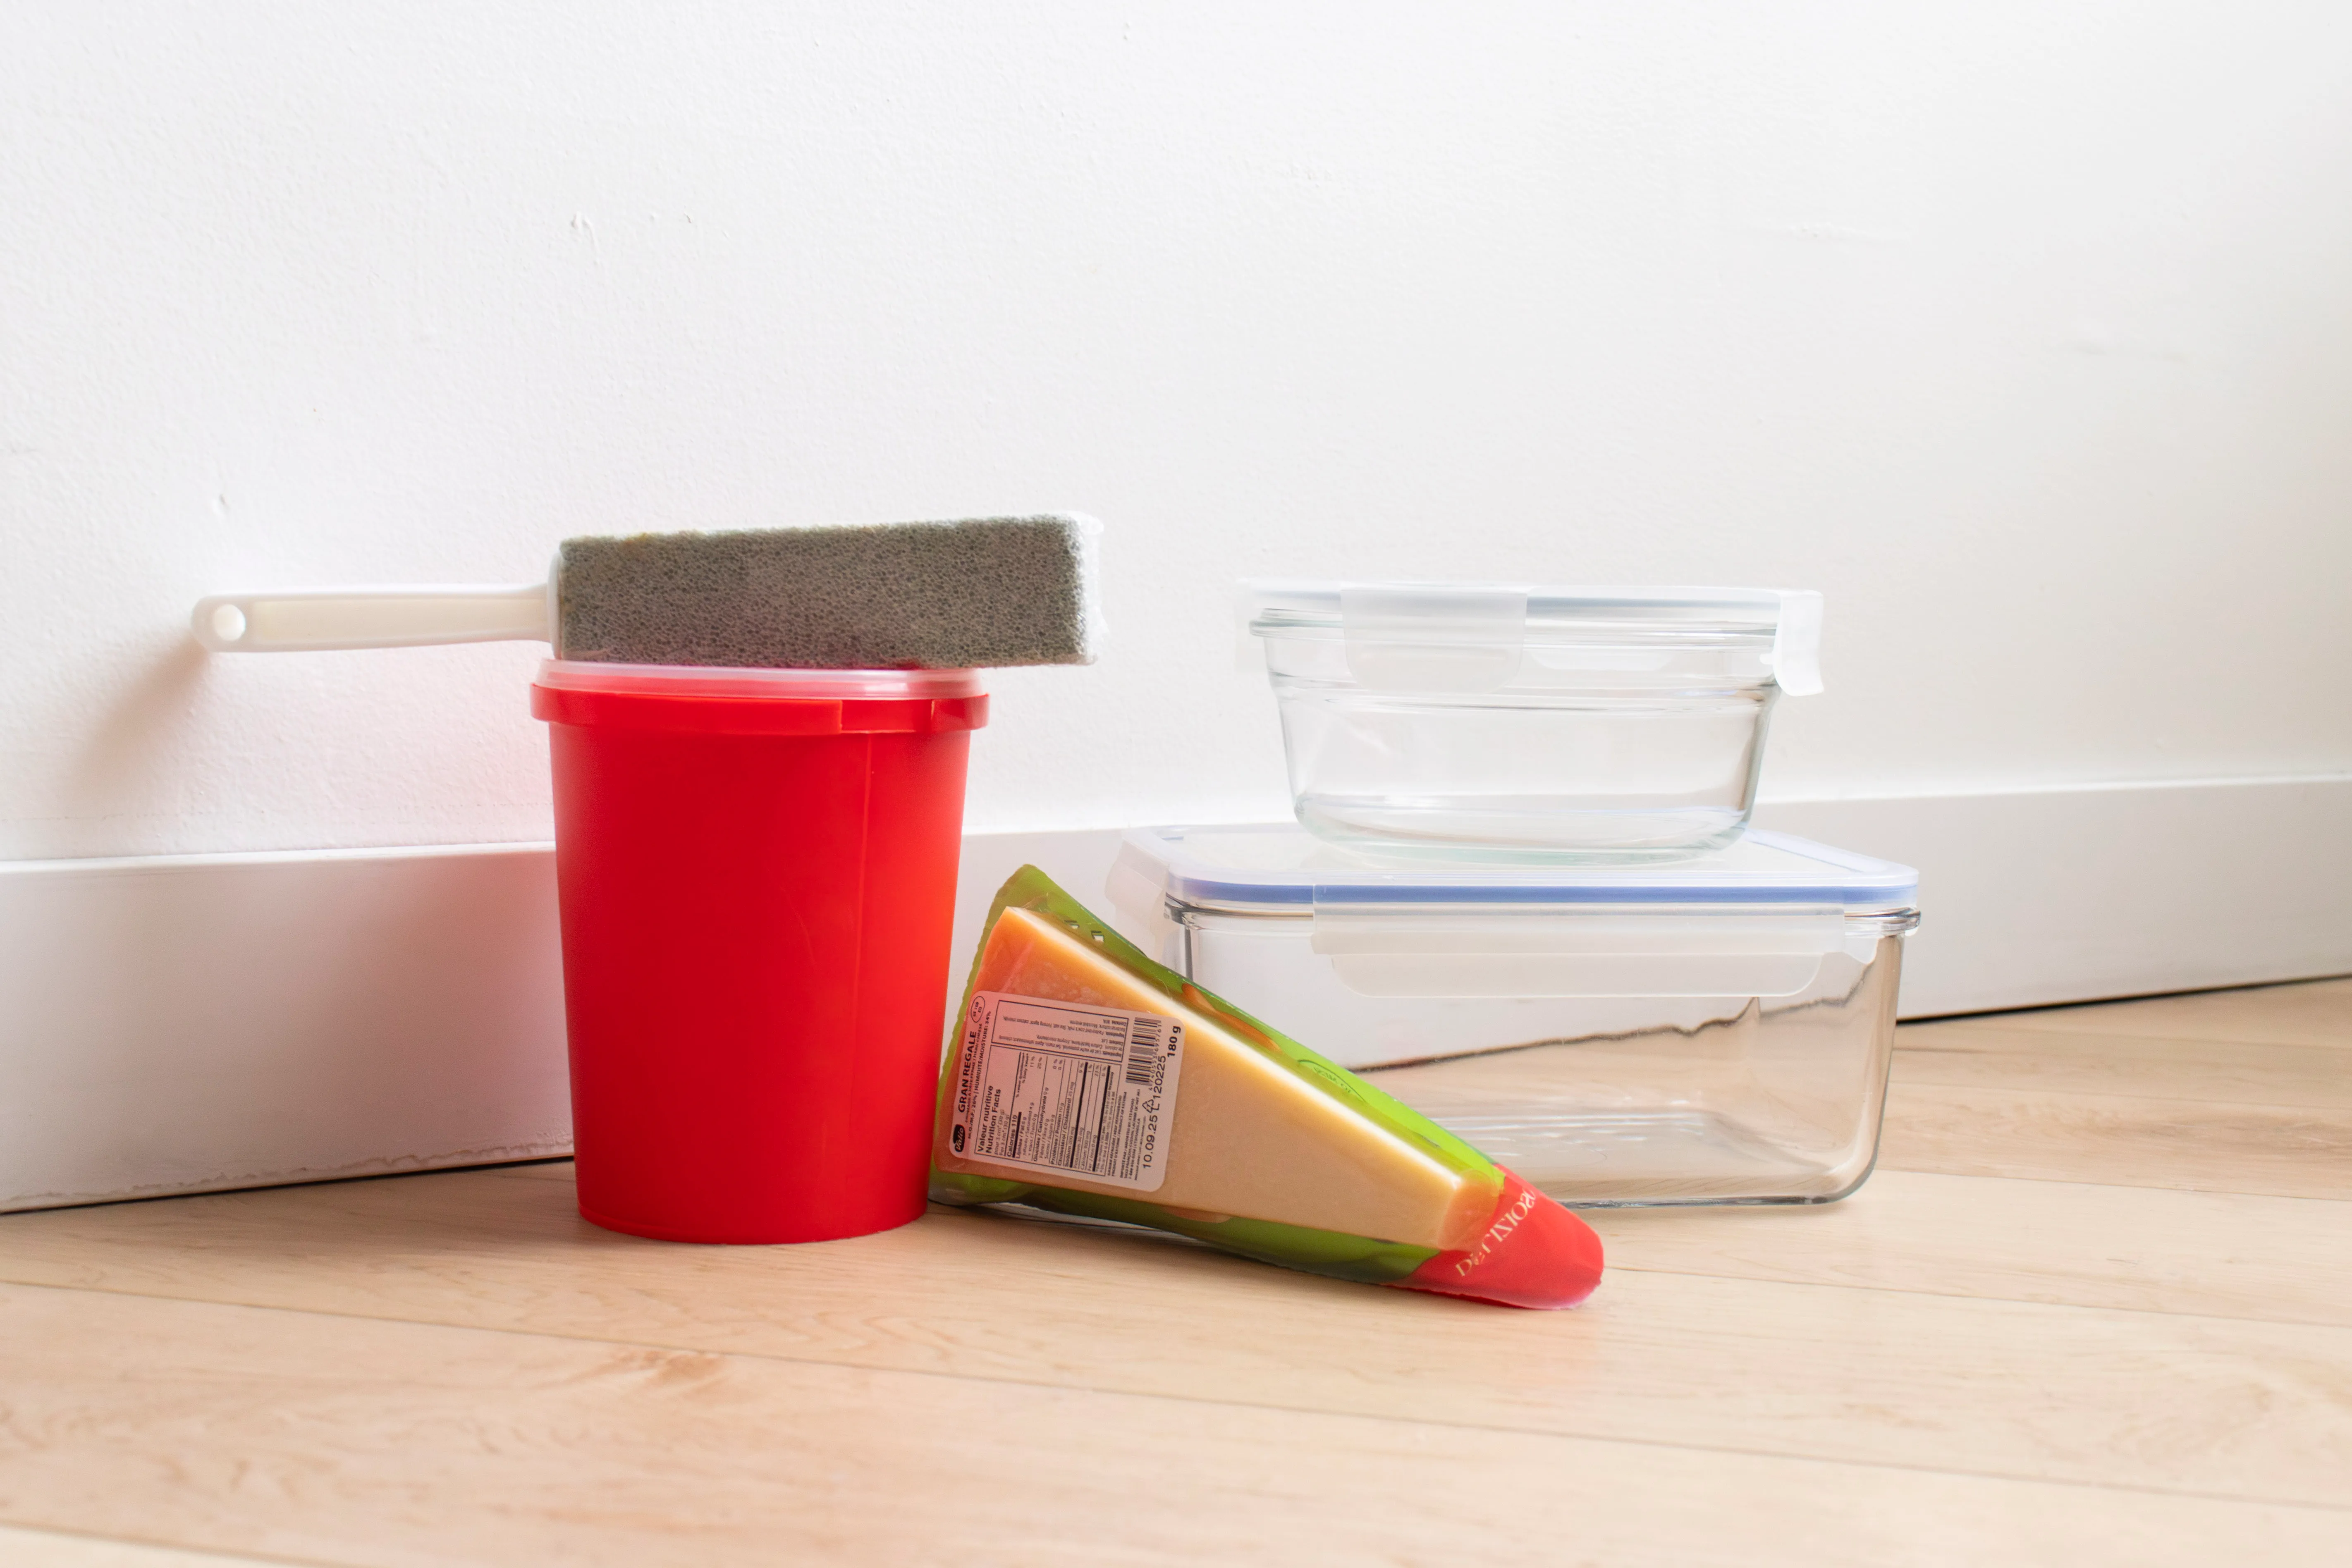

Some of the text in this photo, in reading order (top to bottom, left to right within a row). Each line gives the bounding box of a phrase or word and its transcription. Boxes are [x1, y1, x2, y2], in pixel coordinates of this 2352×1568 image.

[1166, 1025, 1181, 1058] 180 g
[957, 1030, 977, 1113] GRAN REGALE
[955, 1127, 964, 1150] Valio
[977, 1085, 993, 1152] Valeur nutritive
[985, 1114, 997, 1154] Nutrition
[991, 1088, 1001, 1113] Facts
[1006, 1128, 1016, 1157] Calories
[1141, 1114, 1158, 1169] 10.09.25
